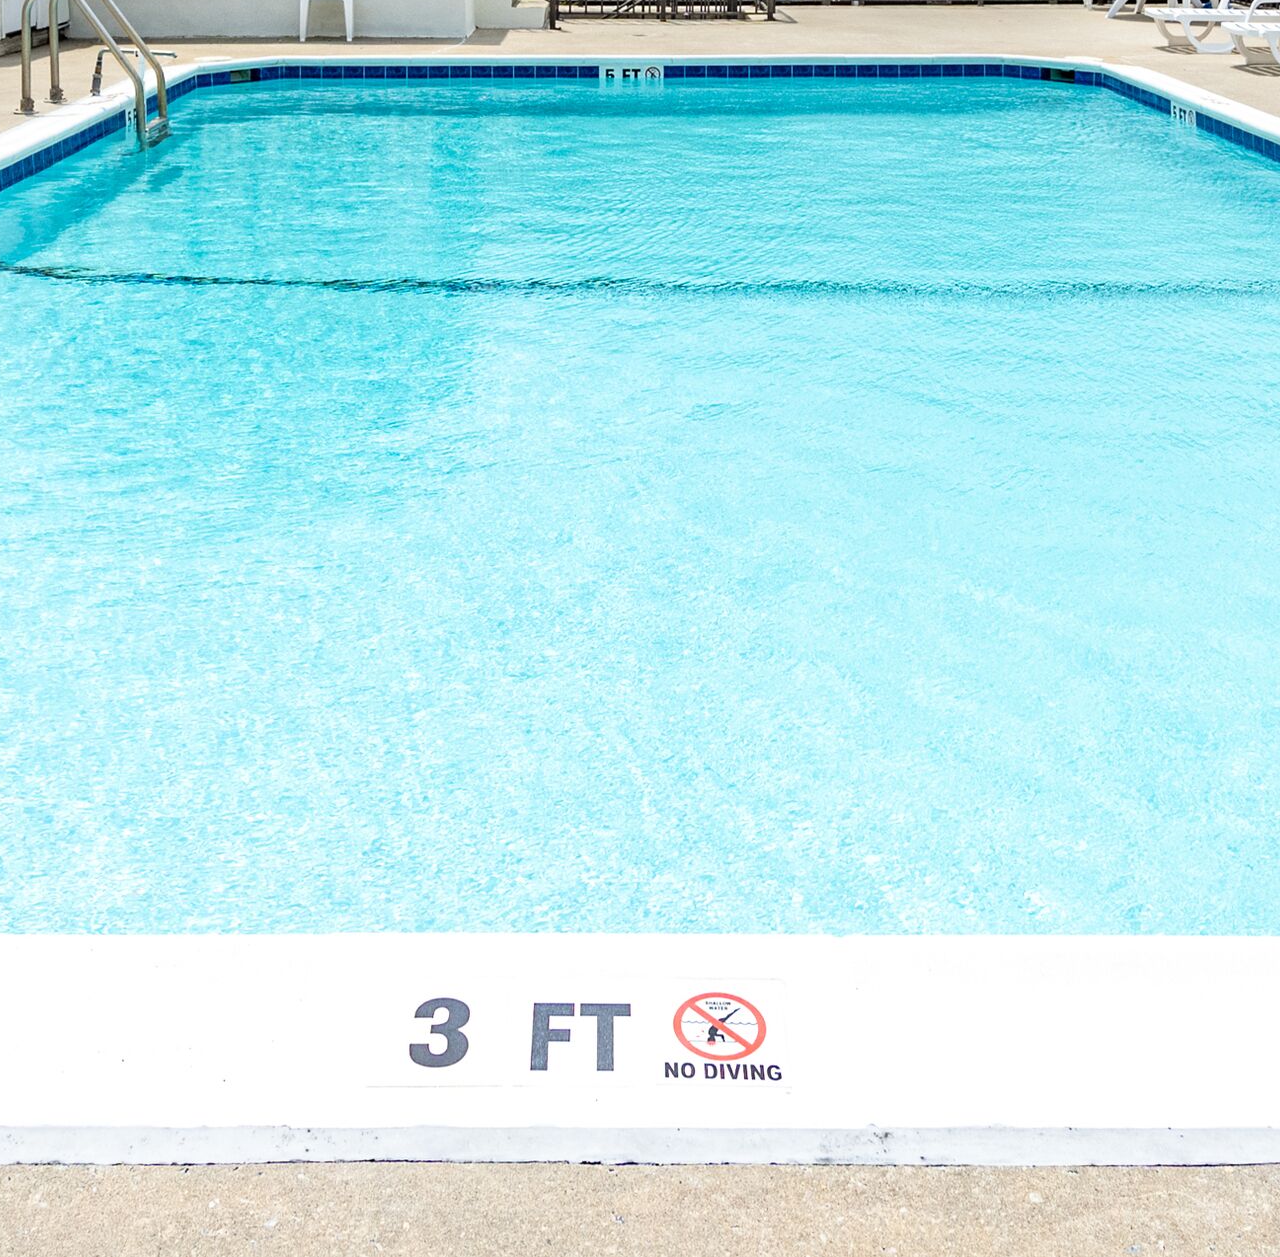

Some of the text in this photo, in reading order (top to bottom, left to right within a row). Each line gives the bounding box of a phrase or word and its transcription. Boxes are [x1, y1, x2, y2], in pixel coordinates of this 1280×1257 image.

[622, 69, 641, 78] FT
[409, 997, 631, 1072] 3 FT
[664, 1062, 783, 1081] NO DIVING
